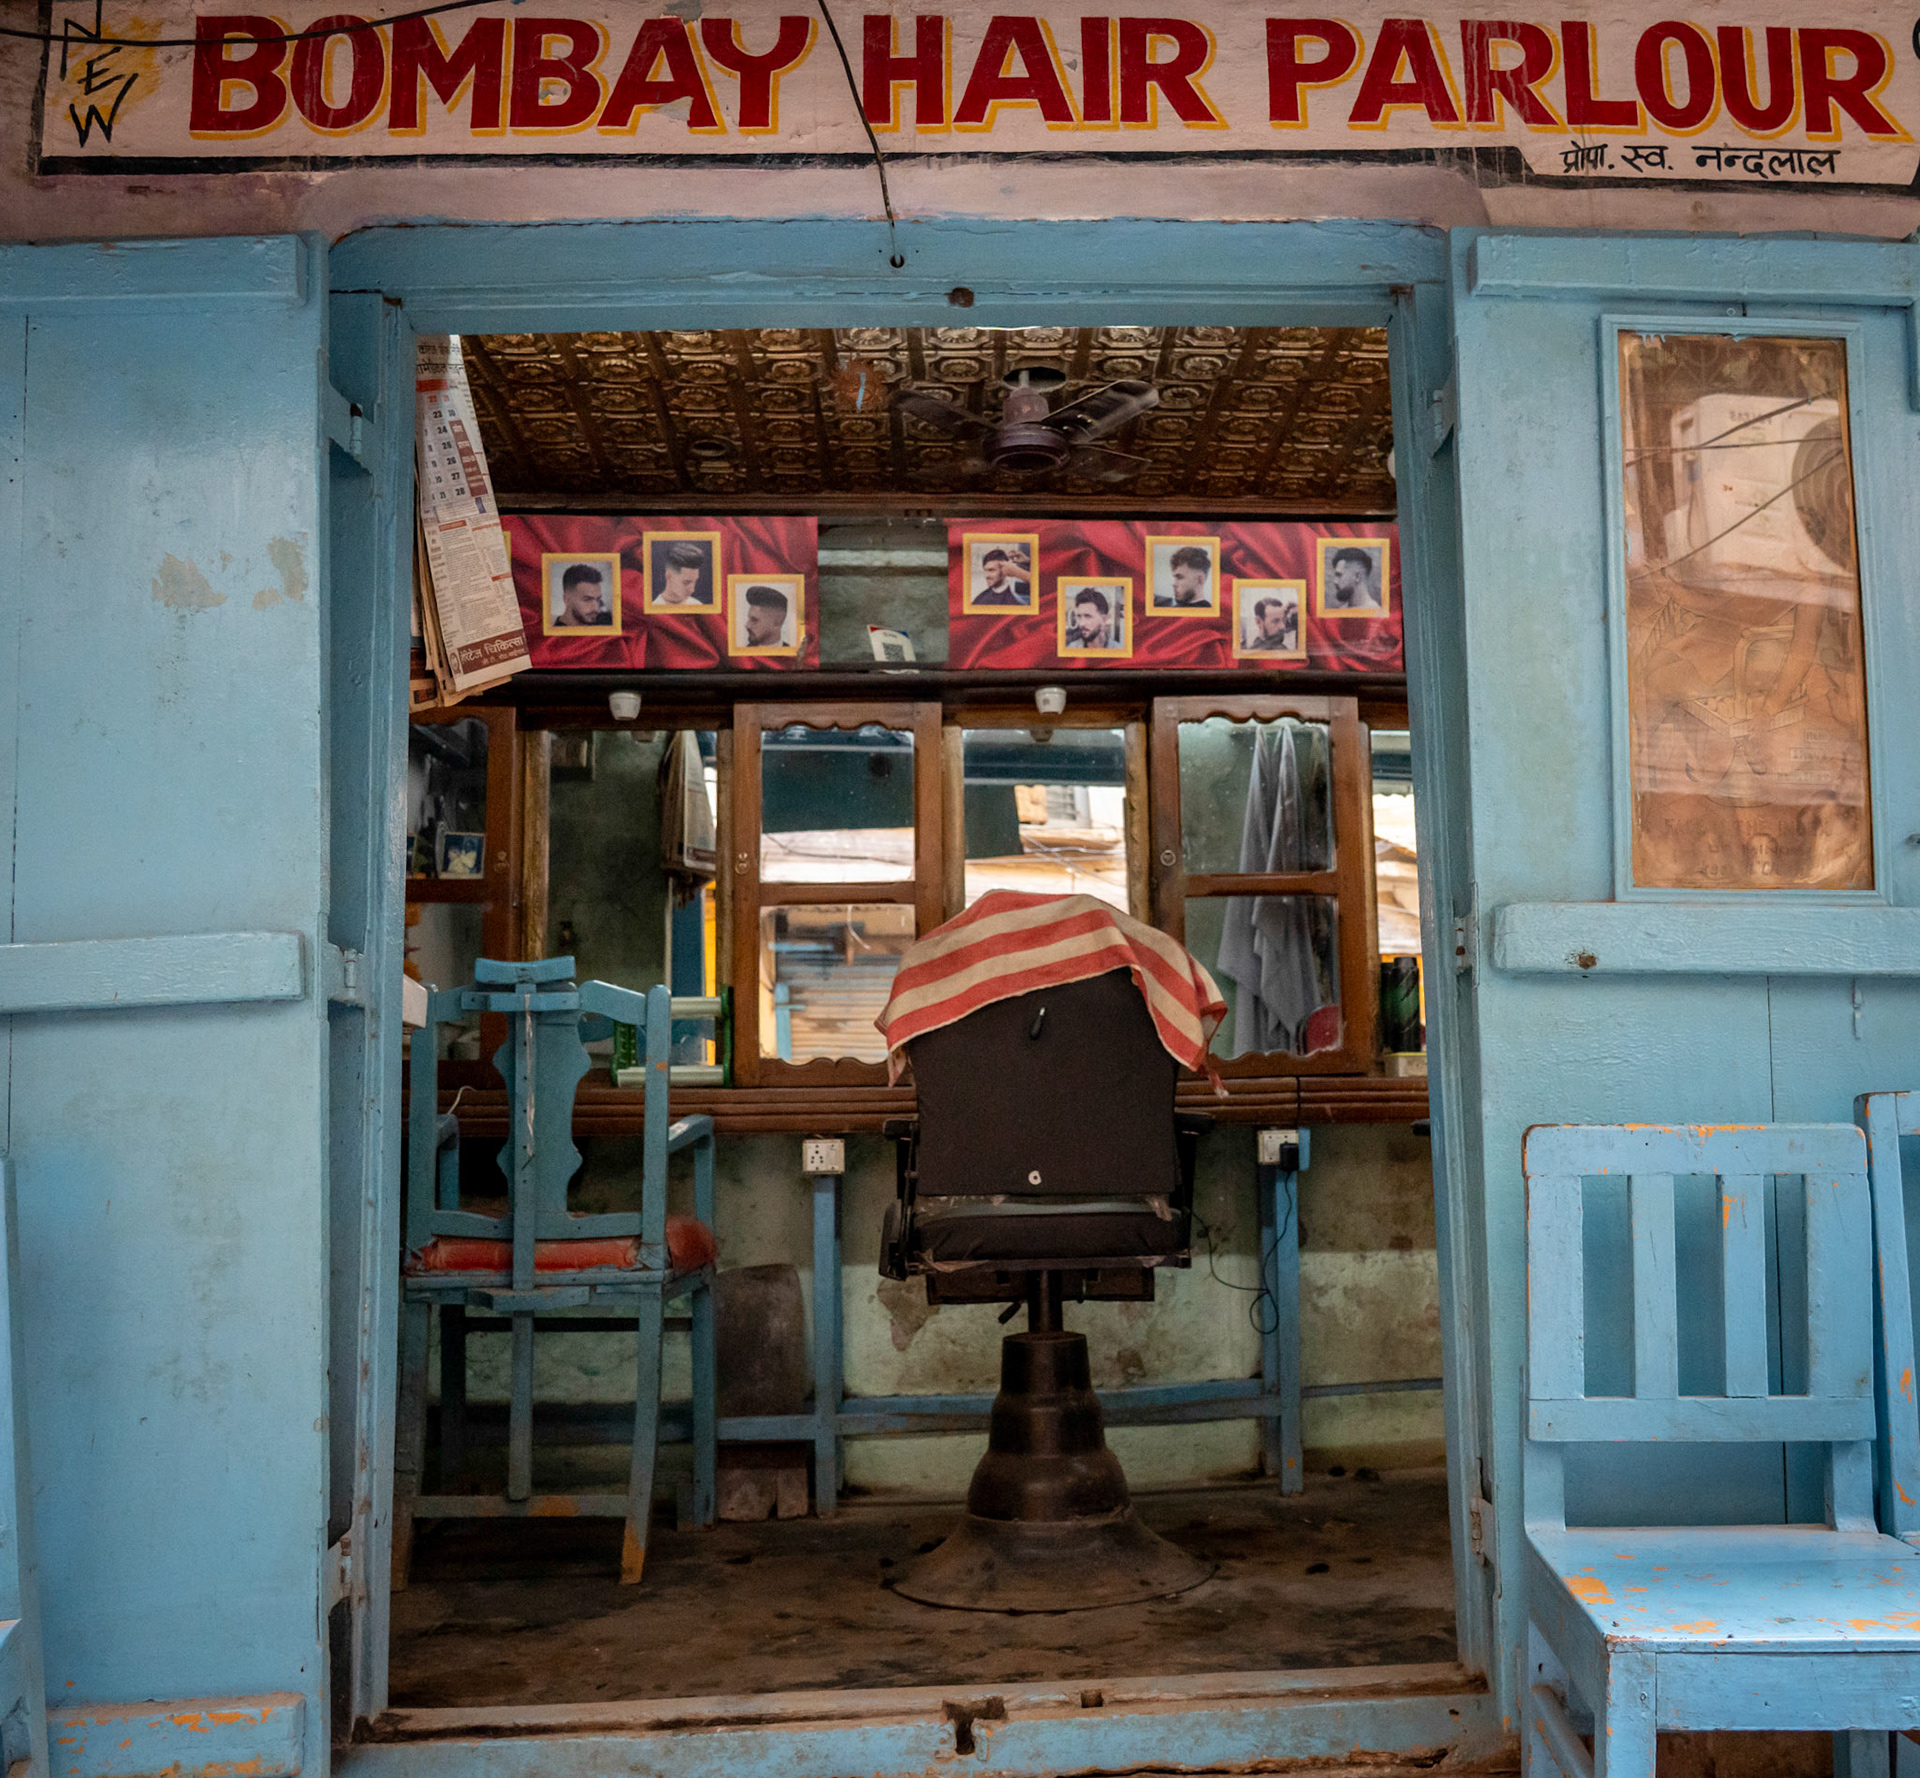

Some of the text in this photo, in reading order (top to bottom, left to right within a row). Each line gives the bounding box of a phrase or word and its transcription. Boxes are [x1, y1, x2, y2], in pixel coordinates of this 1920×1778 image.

[60, 0, 1912, 148] NEW BOMBAY HAIR PARLOUR
[1620, 145, 1674, 173] स्व.
[1691, 145, 1841, 179] नन्दलाल
